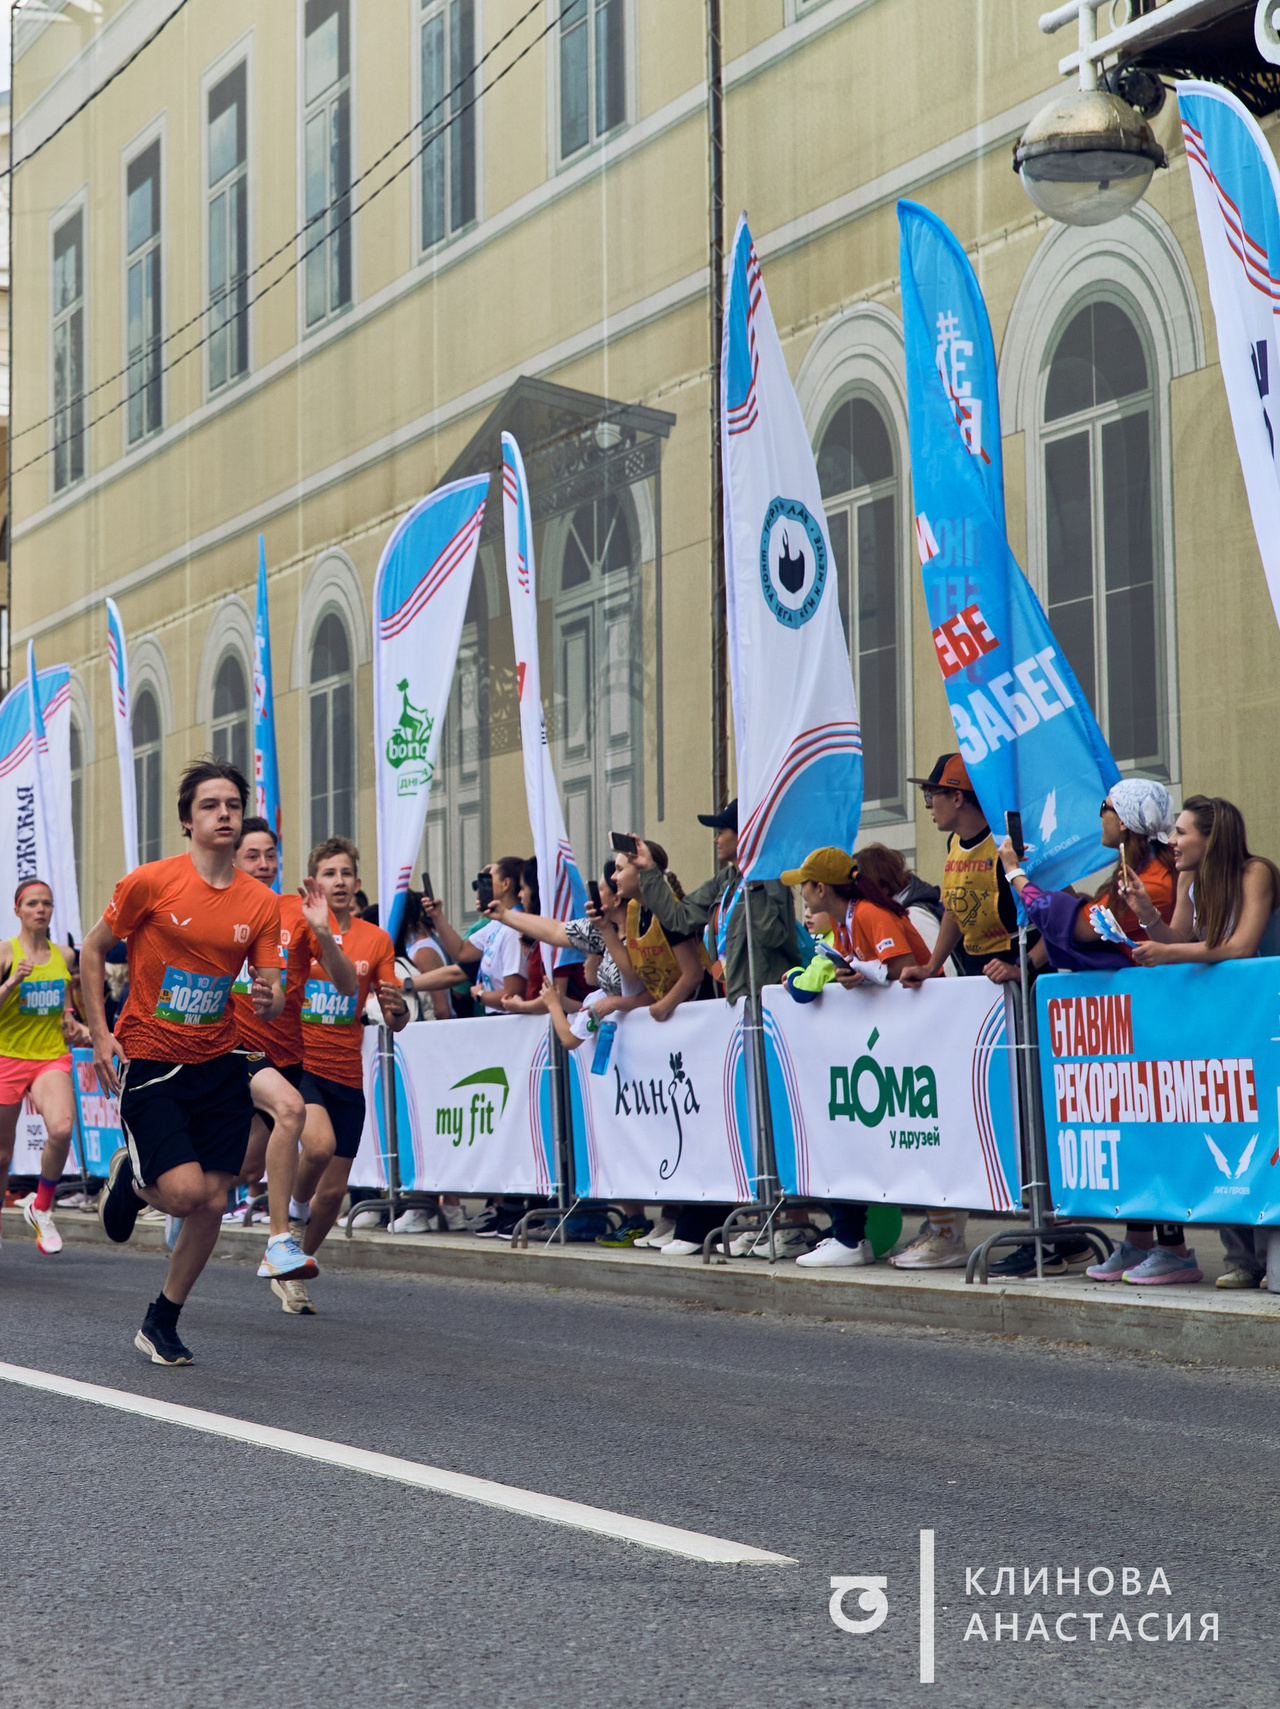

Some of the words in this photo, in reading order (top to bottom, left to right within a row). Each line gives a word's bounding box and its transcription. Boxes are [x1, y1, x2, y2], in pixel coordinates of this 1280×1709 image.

[932, 603, 1000, 680] ЕБЕ
[16, 783, 38, 882] ЕЖСКАЯ
[233, 923, 250, 943] 10
[26, 989, 60, 1008] 10006
[169, 985, 223, 1013] 10262
[310, 992, 349, 1015] 10414
[1048, 994, 1134, 1058] СТАВИМ
[1054, 1061, 1157, 1123] РЕКОРДЫ
[1157, 1058, 1259, 1124] ВМЕСТЕ
[436, 1107, 463, 1147] my
[468, 1093, 494, 1147] fit
[889, 1130, 897, 1149] у
[899, 1126, 940, 1149] друзей
[1058, 1128, 1078, 1190] 10
[1080, 1129, 1121, 1190] ЛЕТ
[1229, 1186, 1251, 1195] ГЕРОЕВ
